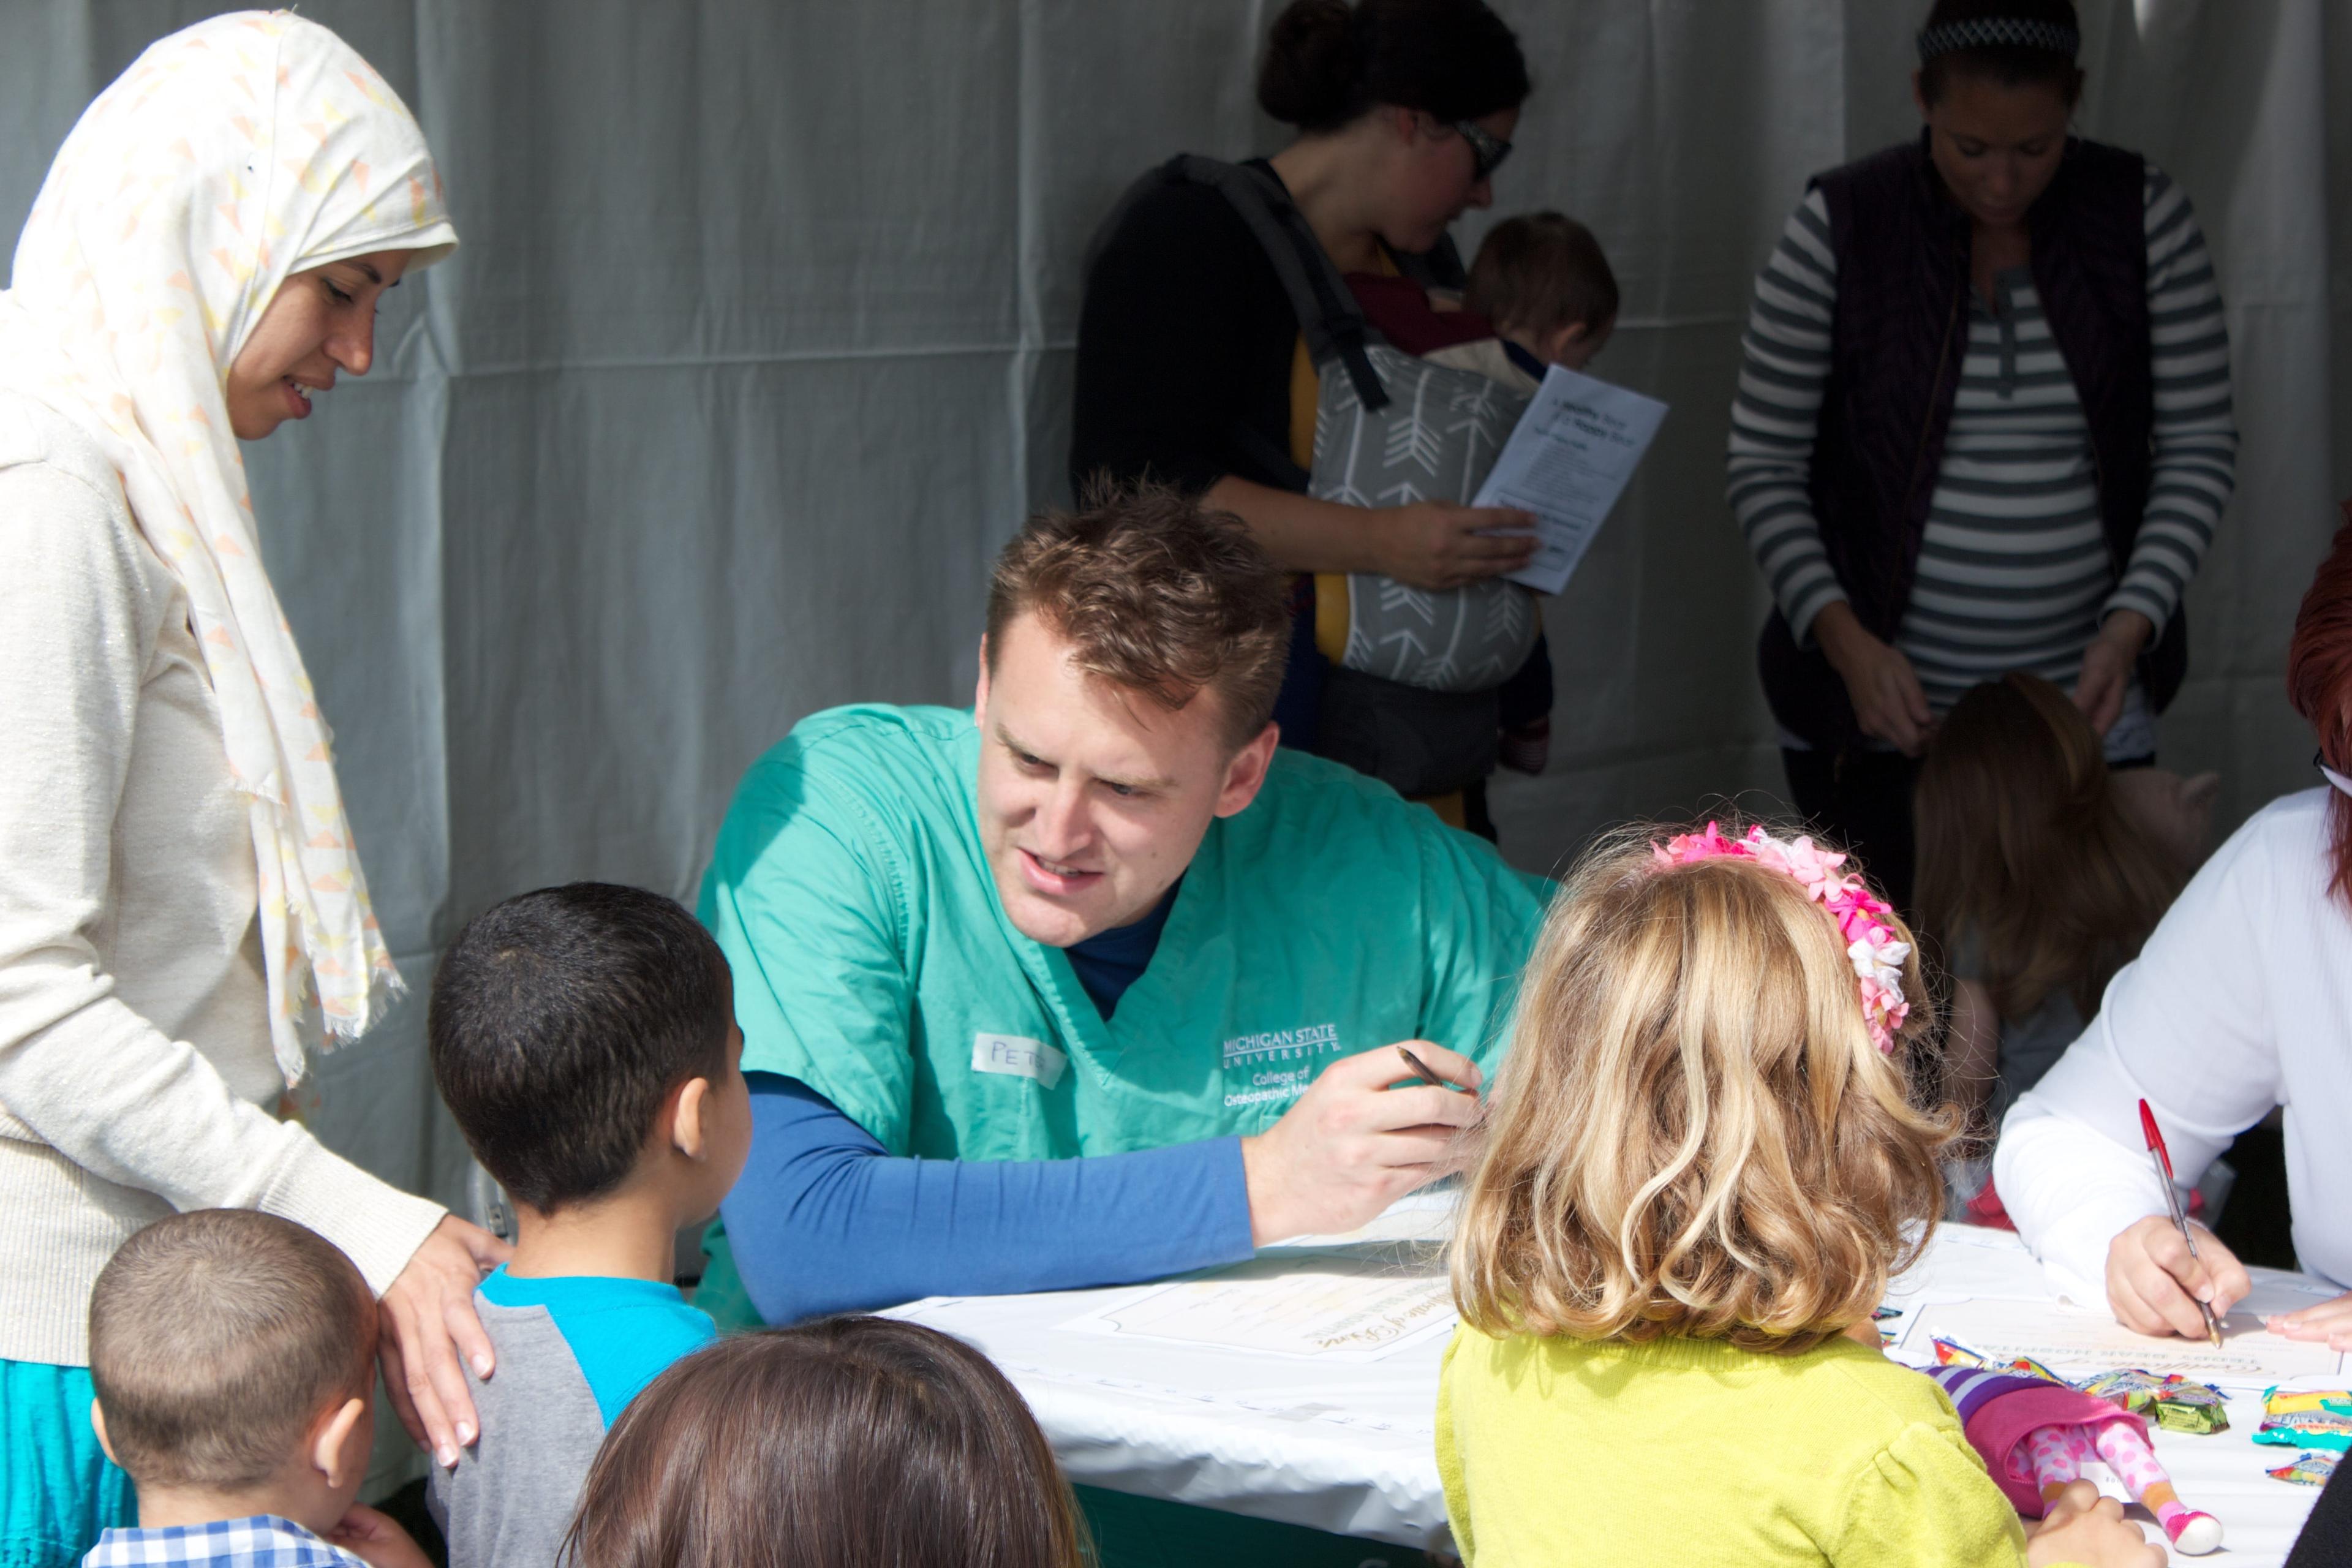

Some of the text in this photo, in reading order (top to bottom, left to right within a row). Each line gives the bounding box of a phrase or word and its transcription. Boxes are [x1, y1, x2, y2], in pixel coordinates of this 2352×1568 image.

[1224, 1024, 1336, 1052] MICHIGAN STATE
[1223, 1042, 1340, 1069] UNIVERSITY
[1253, 1066, 1310, 1086] College of
[1224, 1083, 1309, 1107] Osteopathic Me
